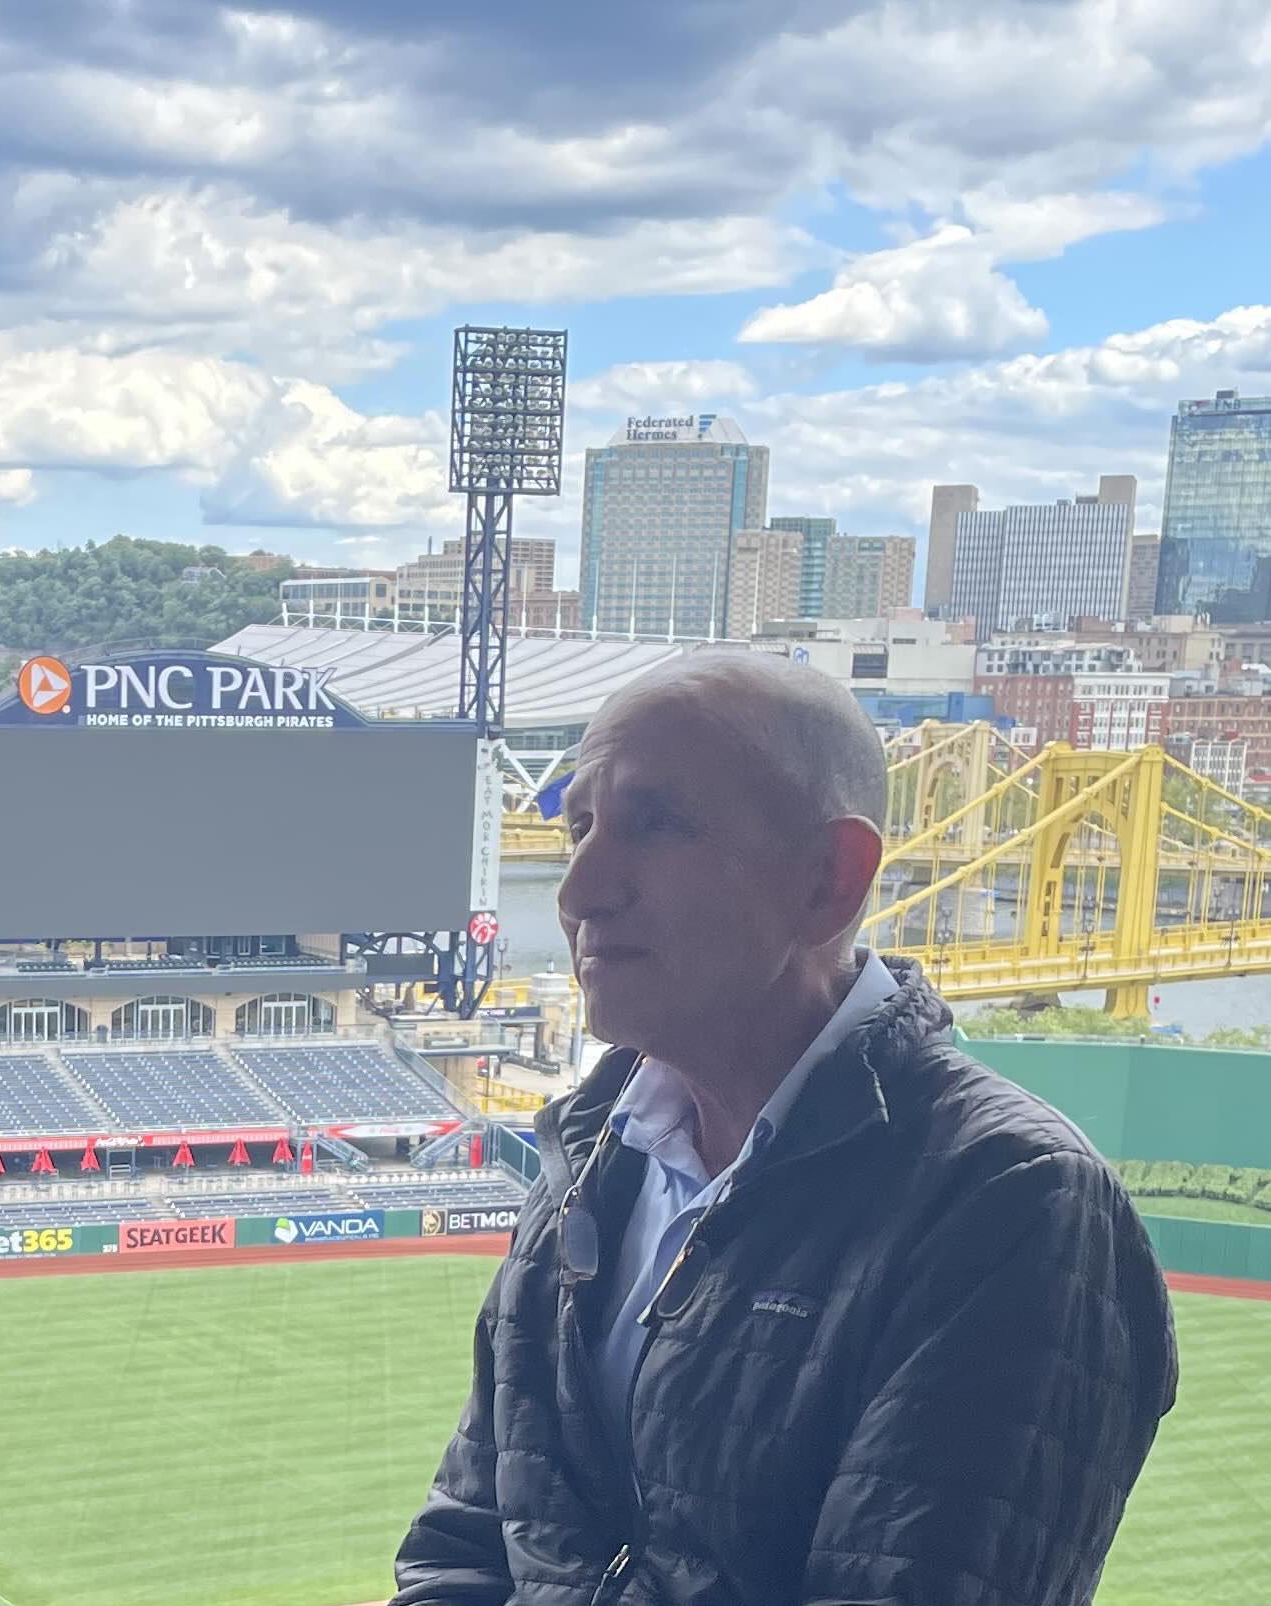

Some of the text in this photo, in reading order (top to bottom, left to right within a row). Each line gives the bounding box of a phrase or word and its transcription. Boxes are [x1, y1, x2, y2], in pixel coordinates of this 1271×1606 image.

[627, 415, 693, 428] Federated
[626, 429, 677, 440] Hermes
[81, 665, 337, 710] PNC PARK
[87, 713, 335, 728] HOME OF THE PITTSBURGH PIRATES
[126, 1222, 228, 1248] SEATGEEK
[299, 1217, 380, 1236] VANDA
